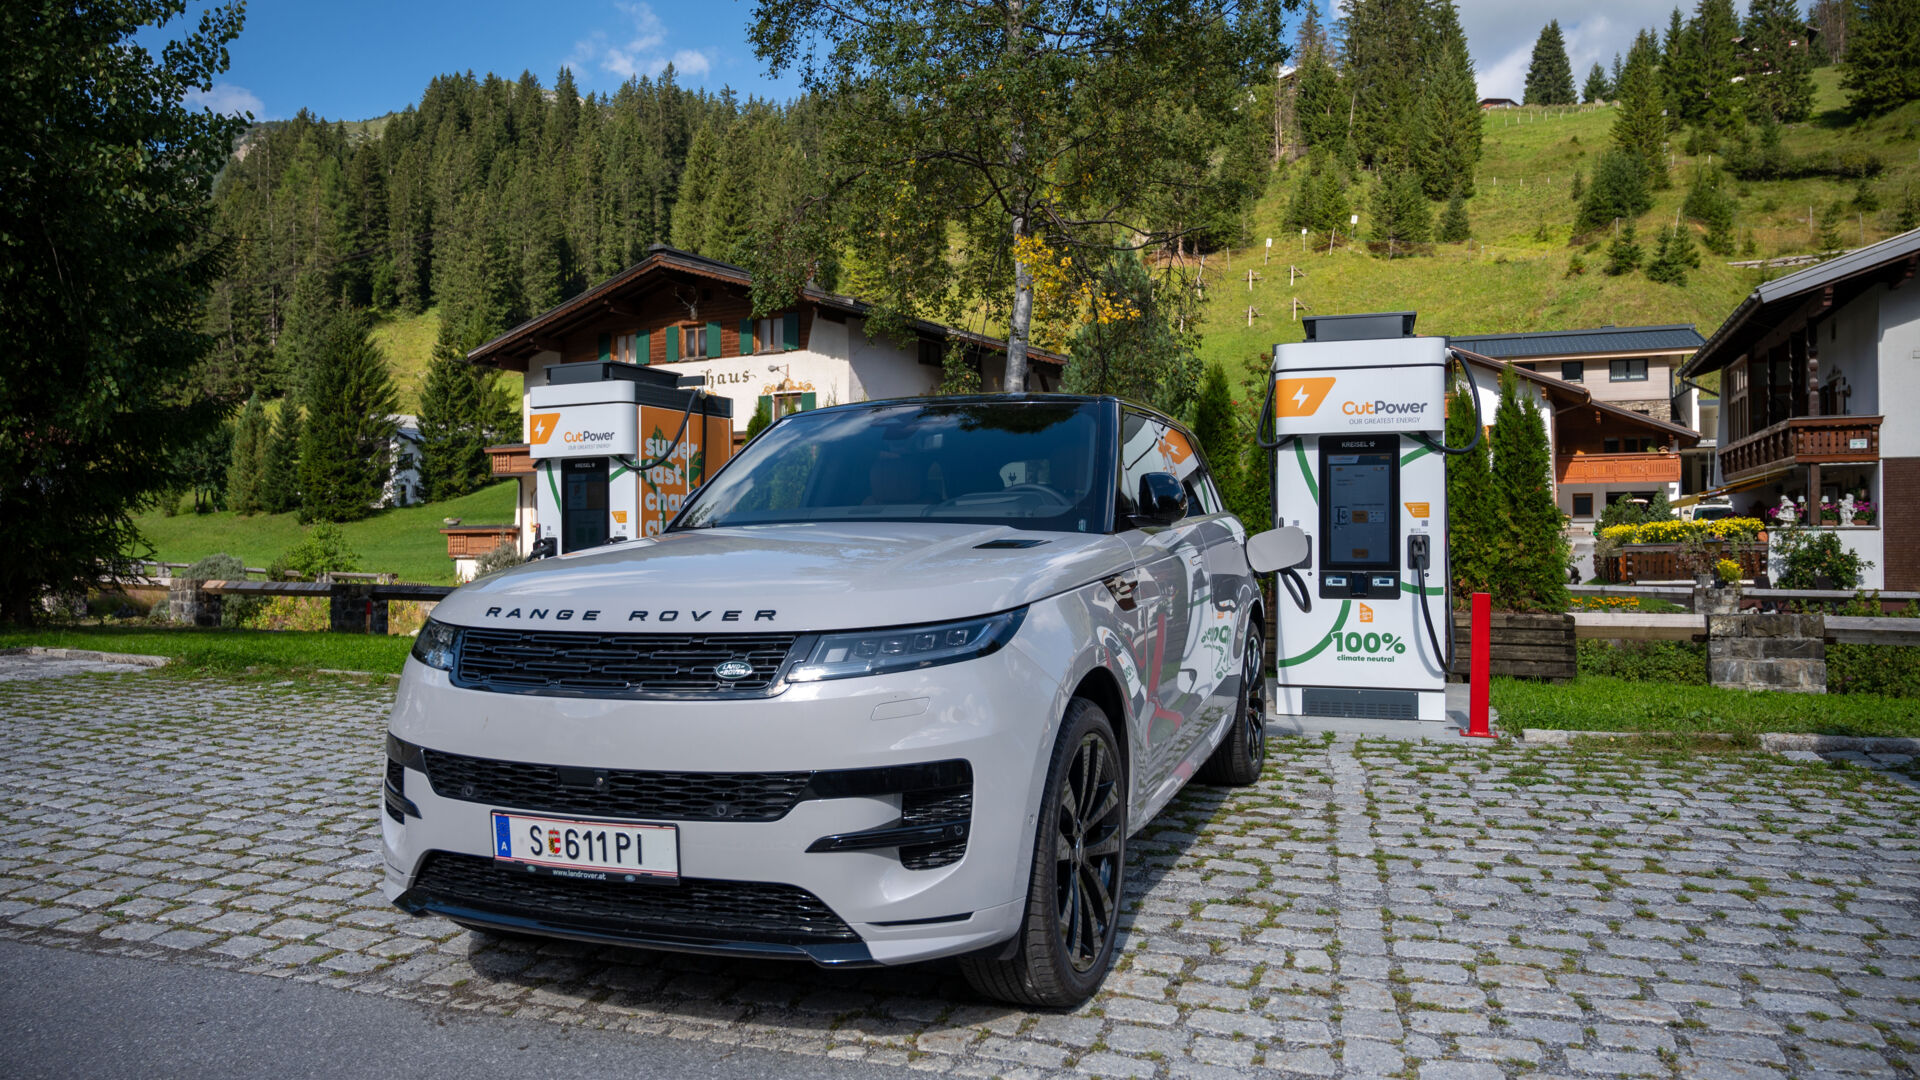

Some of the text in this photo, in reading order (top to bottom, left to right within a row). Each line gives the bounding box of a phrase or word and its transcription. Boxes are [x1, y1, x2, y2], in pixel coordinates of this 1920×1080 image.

[1341, 400, 1428, 416] CutPower
[1364, 417, 1395, 425] GREATEST
[1396, 416, 1421, 424] ENERGY
[563, 430, 616, 443] CutPower
[645, 437, 698, 462] super
[645, 458, 682, 486] fast
[485, 606, 777, 622] RANGE ROVER
[1332, 631, 1406, 654] 100%
[1336, 654, 1395, 663] climate neutral
[722, 668, 746, 676] ROVER
[501, 841, 508, 851] A
[552, 869, 607, 880] www.landrover.at
